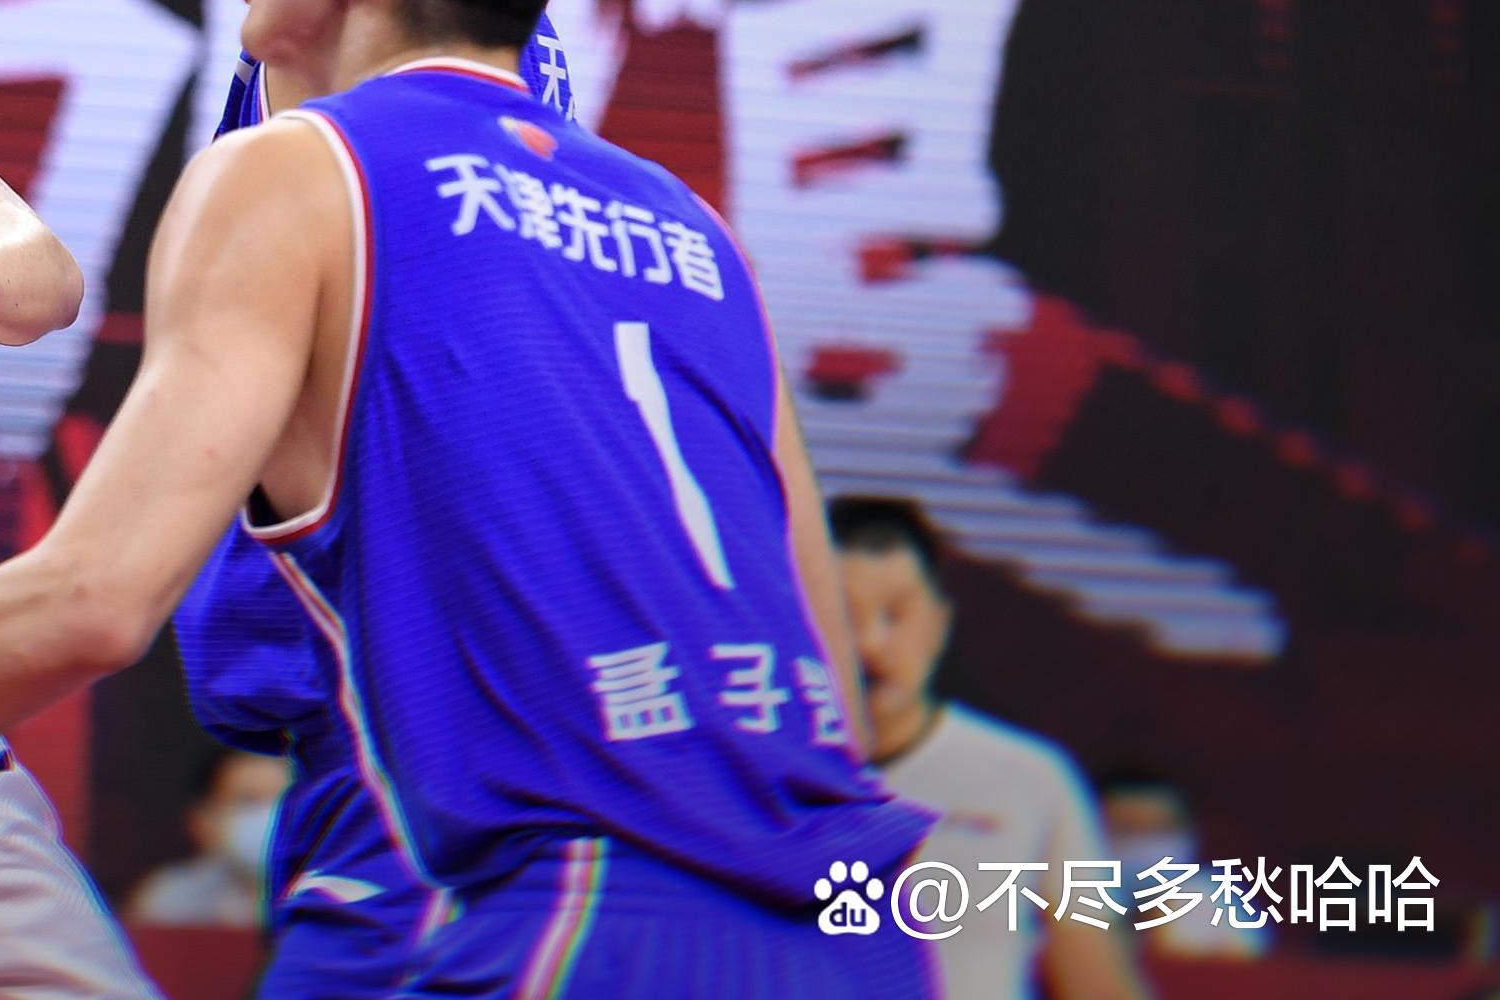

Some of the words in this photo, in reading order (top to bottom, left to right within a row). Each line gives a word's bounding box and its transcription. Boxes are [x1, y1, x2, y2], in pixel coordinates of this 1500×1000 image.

[425, 153, 724, 301] 天津先行者
[612, 321, 733, 590] 1
